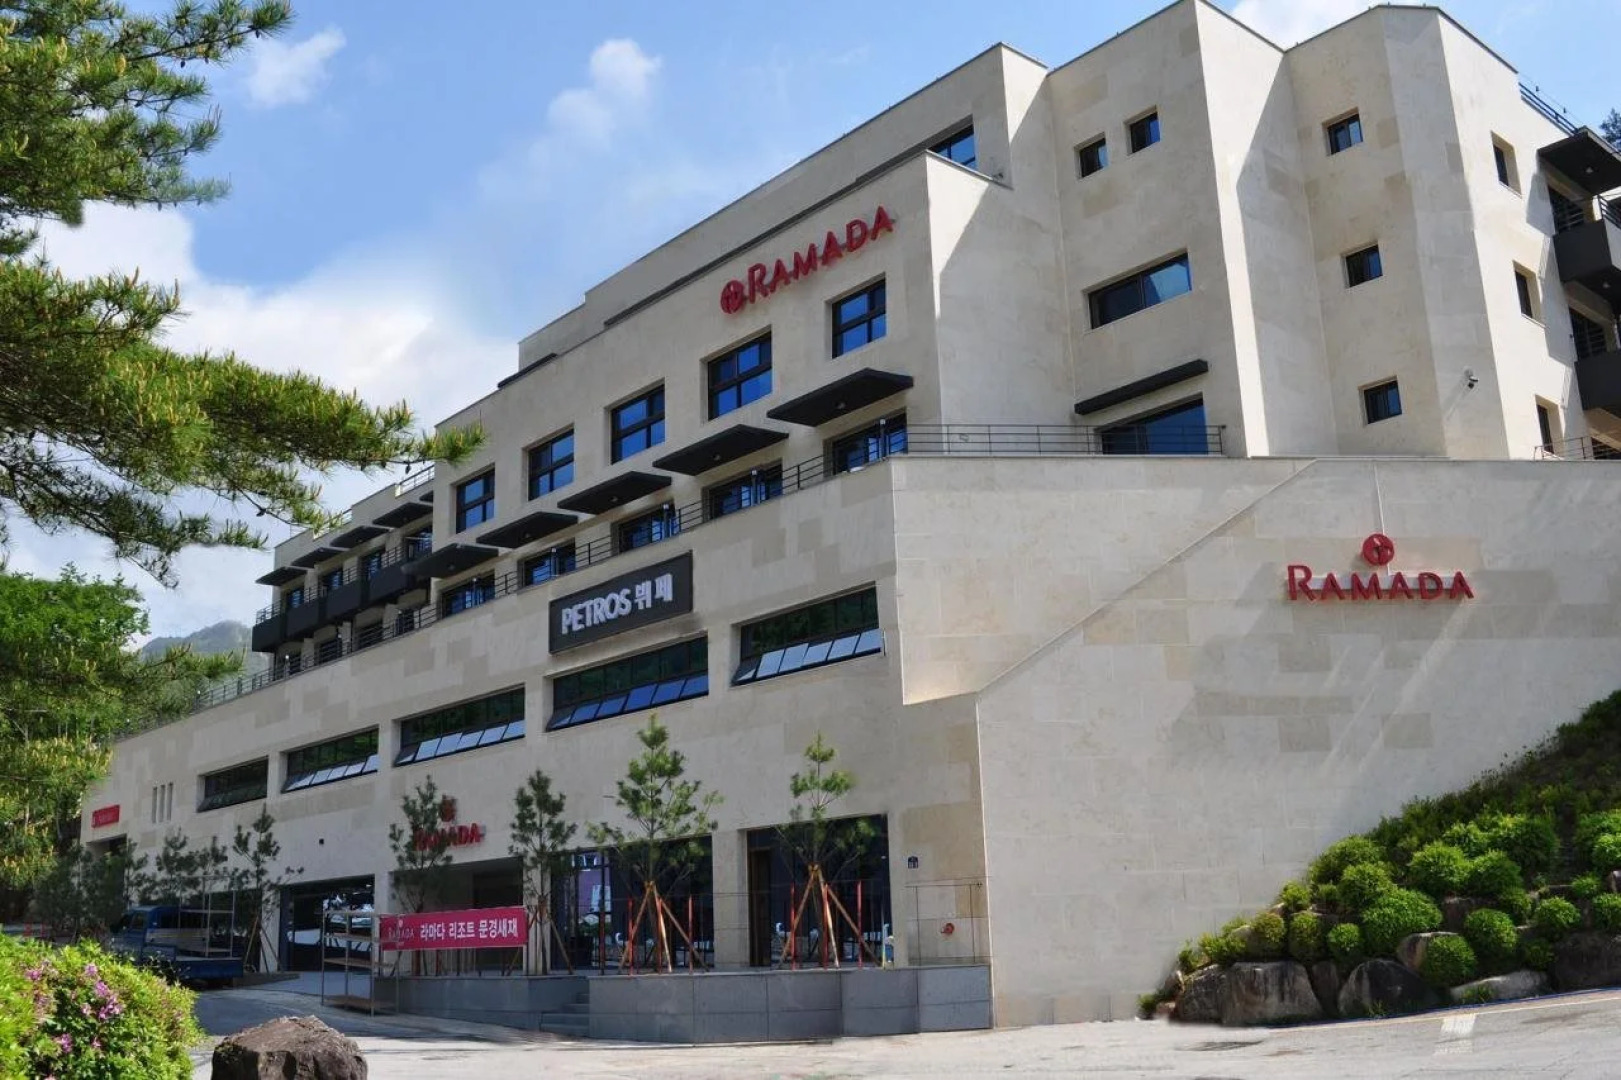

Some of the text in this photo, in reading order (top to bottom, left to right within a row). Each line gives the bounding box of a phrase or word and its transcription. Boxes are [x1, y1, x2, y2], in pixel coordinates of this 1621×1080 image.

[748, 205, 893, 303] RAMADA
[1287, 565, 1474, 601] RAMADA
[562, 588, 631, 634] PETROS
[420, 922, 446, 941] 라마다
[449, 921, 476, 940] 리조트
[478, 918, 519, 939] 문경새재
